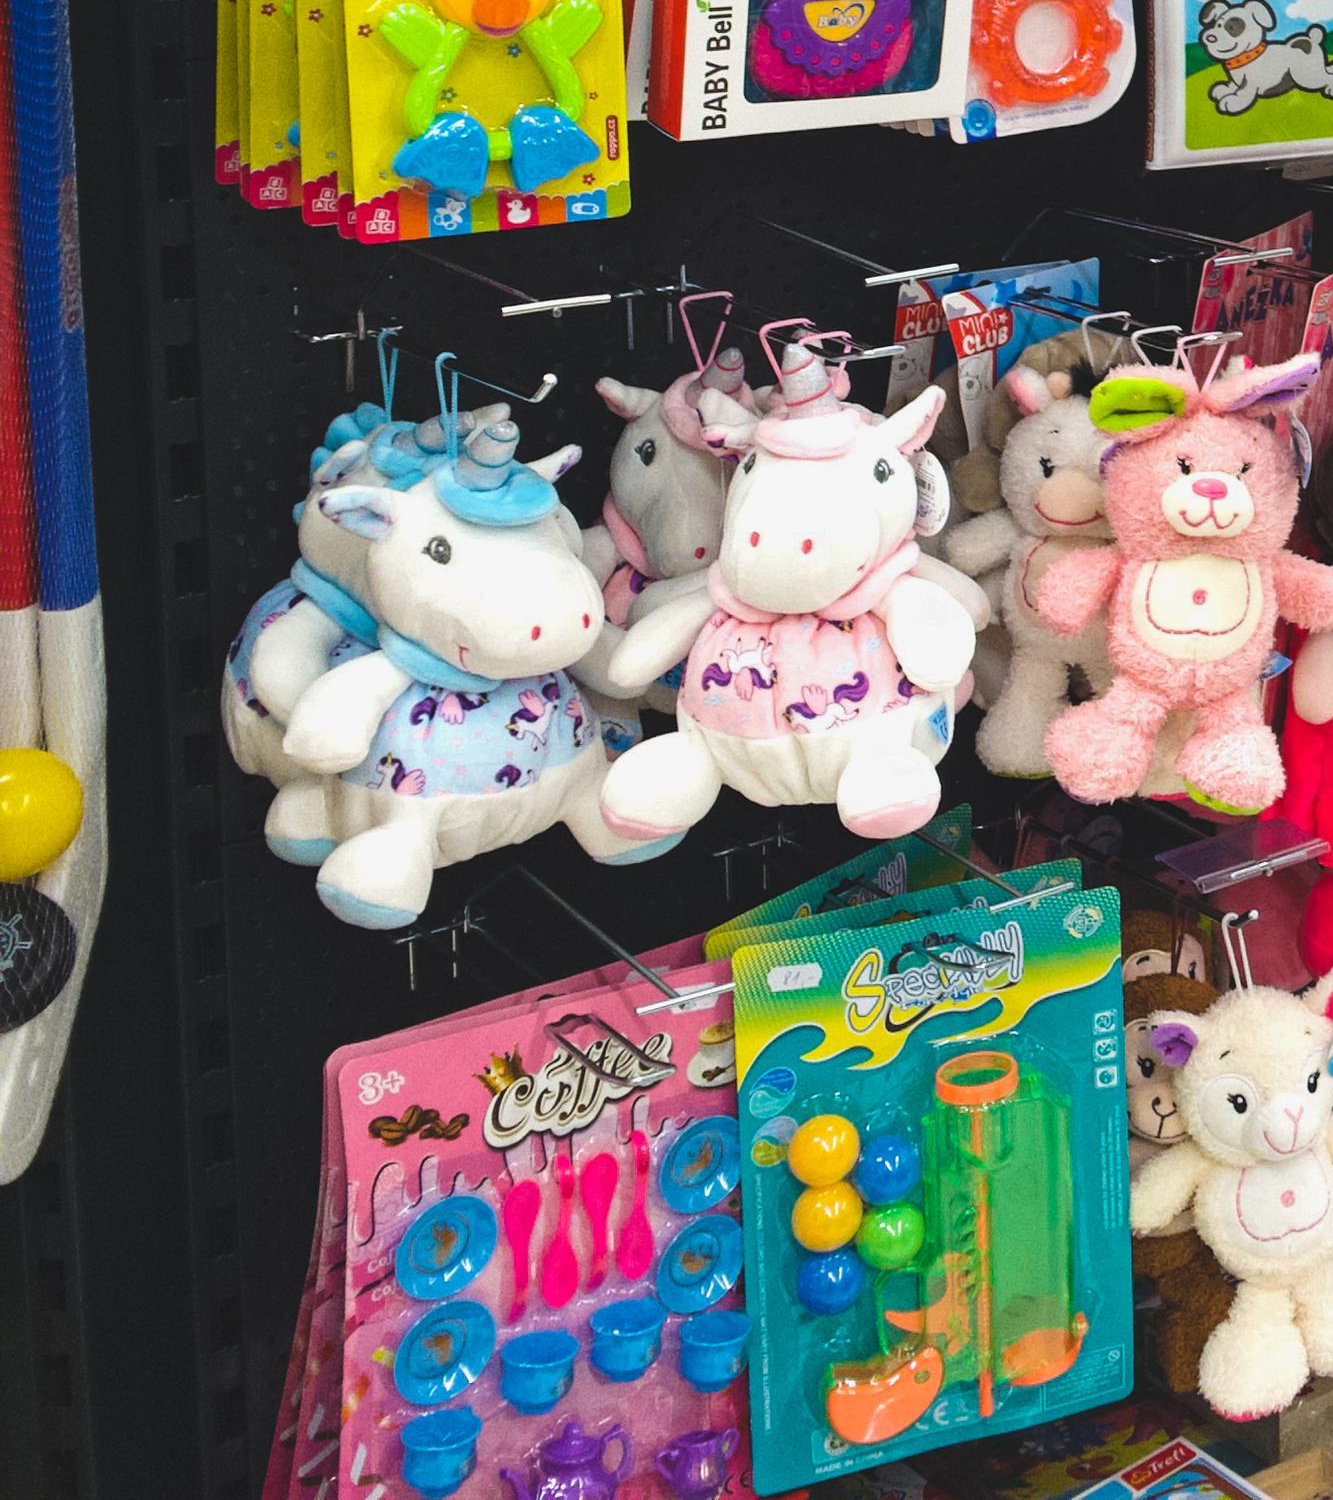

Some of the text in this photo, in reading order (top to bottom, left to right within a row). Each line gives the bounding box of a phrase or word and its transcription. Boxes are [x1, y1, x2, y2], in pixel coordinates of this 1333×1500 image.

[702, 5, 733, 131] BABY Bell
[962, 329, 1009, 355] CLUB
[358, 1070, 406, 1106] 3+
[489, 1034, 672, 1137] Coffee
[815, 1463, 844, 1476] MADE
